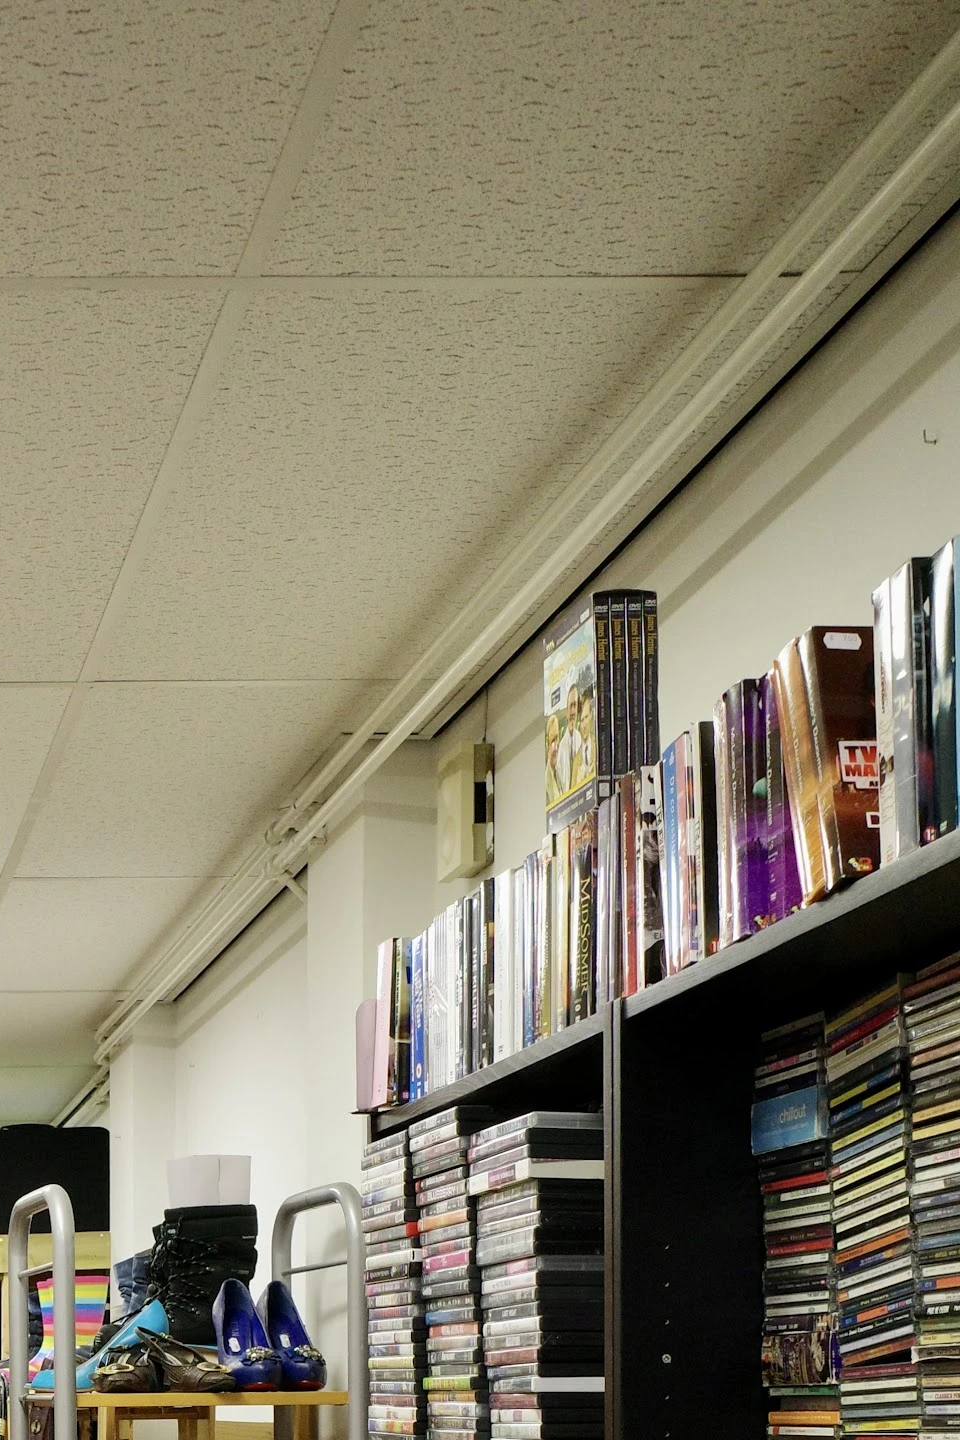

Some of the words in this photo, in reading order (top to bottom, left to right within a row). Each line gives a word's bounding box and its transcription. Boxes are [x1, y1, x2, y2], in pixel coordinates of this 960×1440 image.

[845, 764, 879, 777] MA
[779, 1103, 807, 1123] chillout
[425, 1186, 457, 1202] BLUEBERRY
